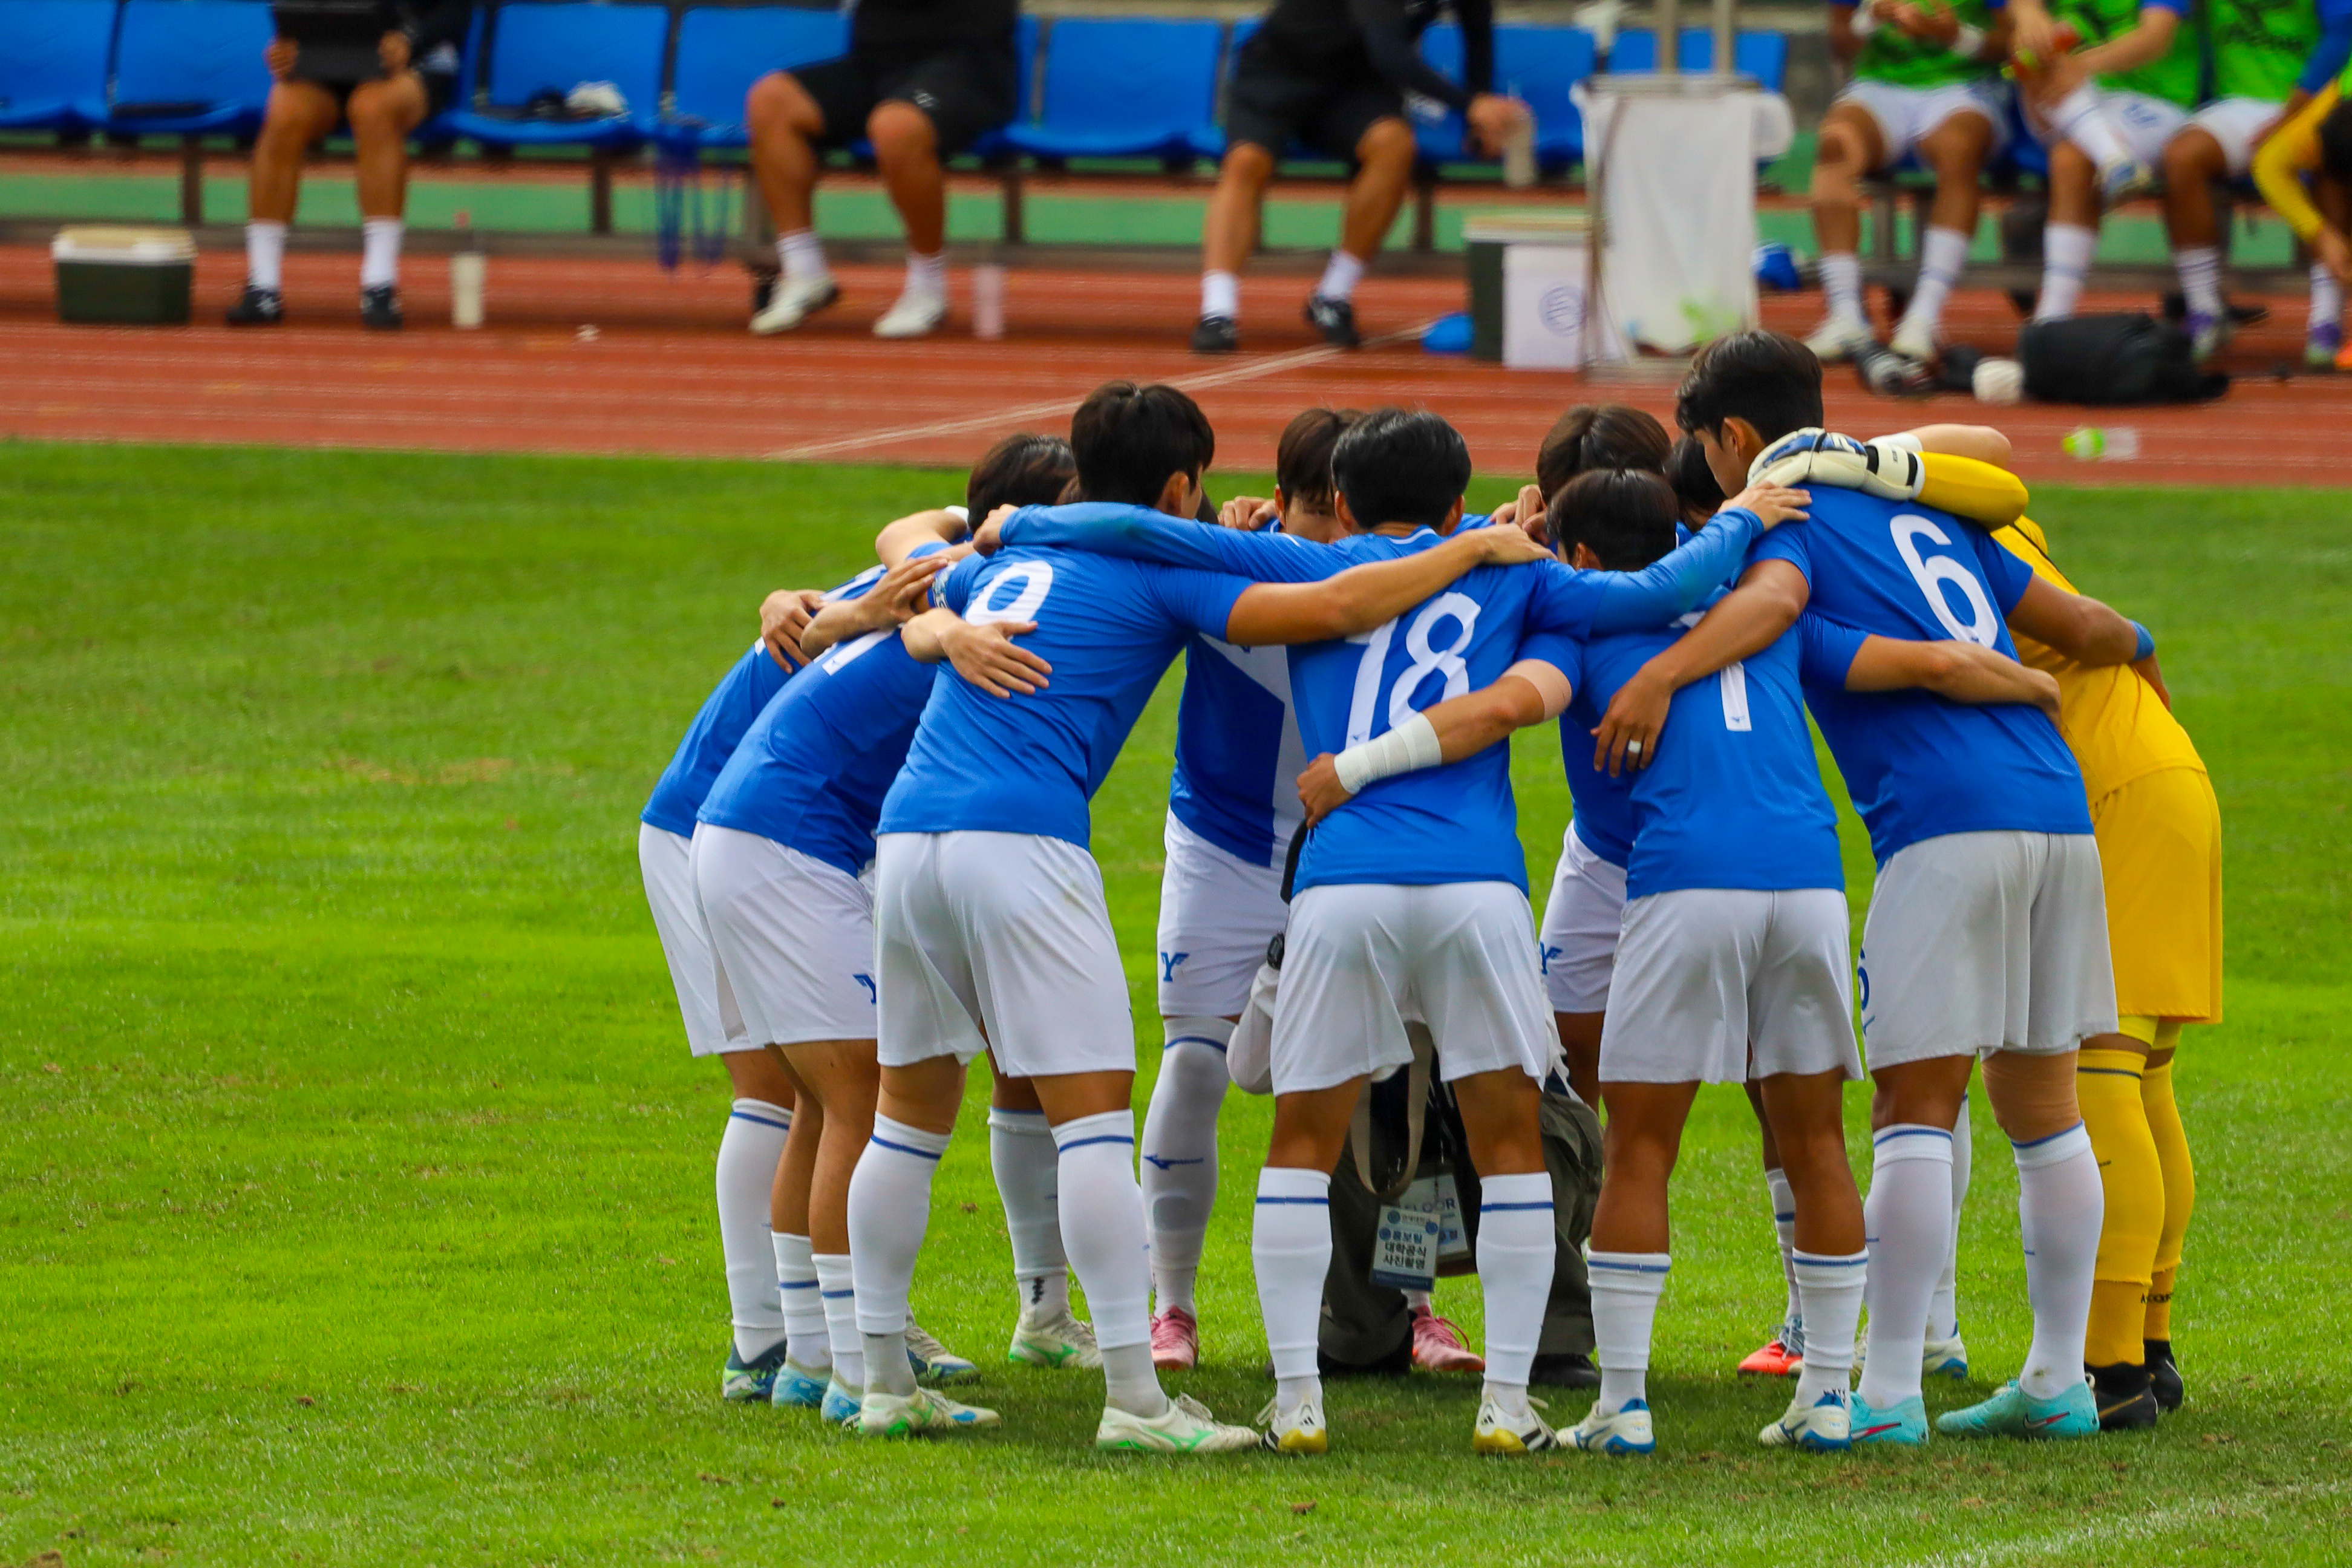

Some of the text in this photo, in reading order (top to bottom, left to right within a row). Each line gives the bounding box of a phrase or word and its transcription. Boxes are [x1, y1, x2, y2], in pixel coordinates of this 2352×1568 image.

[1890, 514, 1998, 650] 6
[1344, 591, 1481, 750] 18
[1160, 952, 1191, 982] Y
[1385, 1241, 1426, 1257] 대학공식
